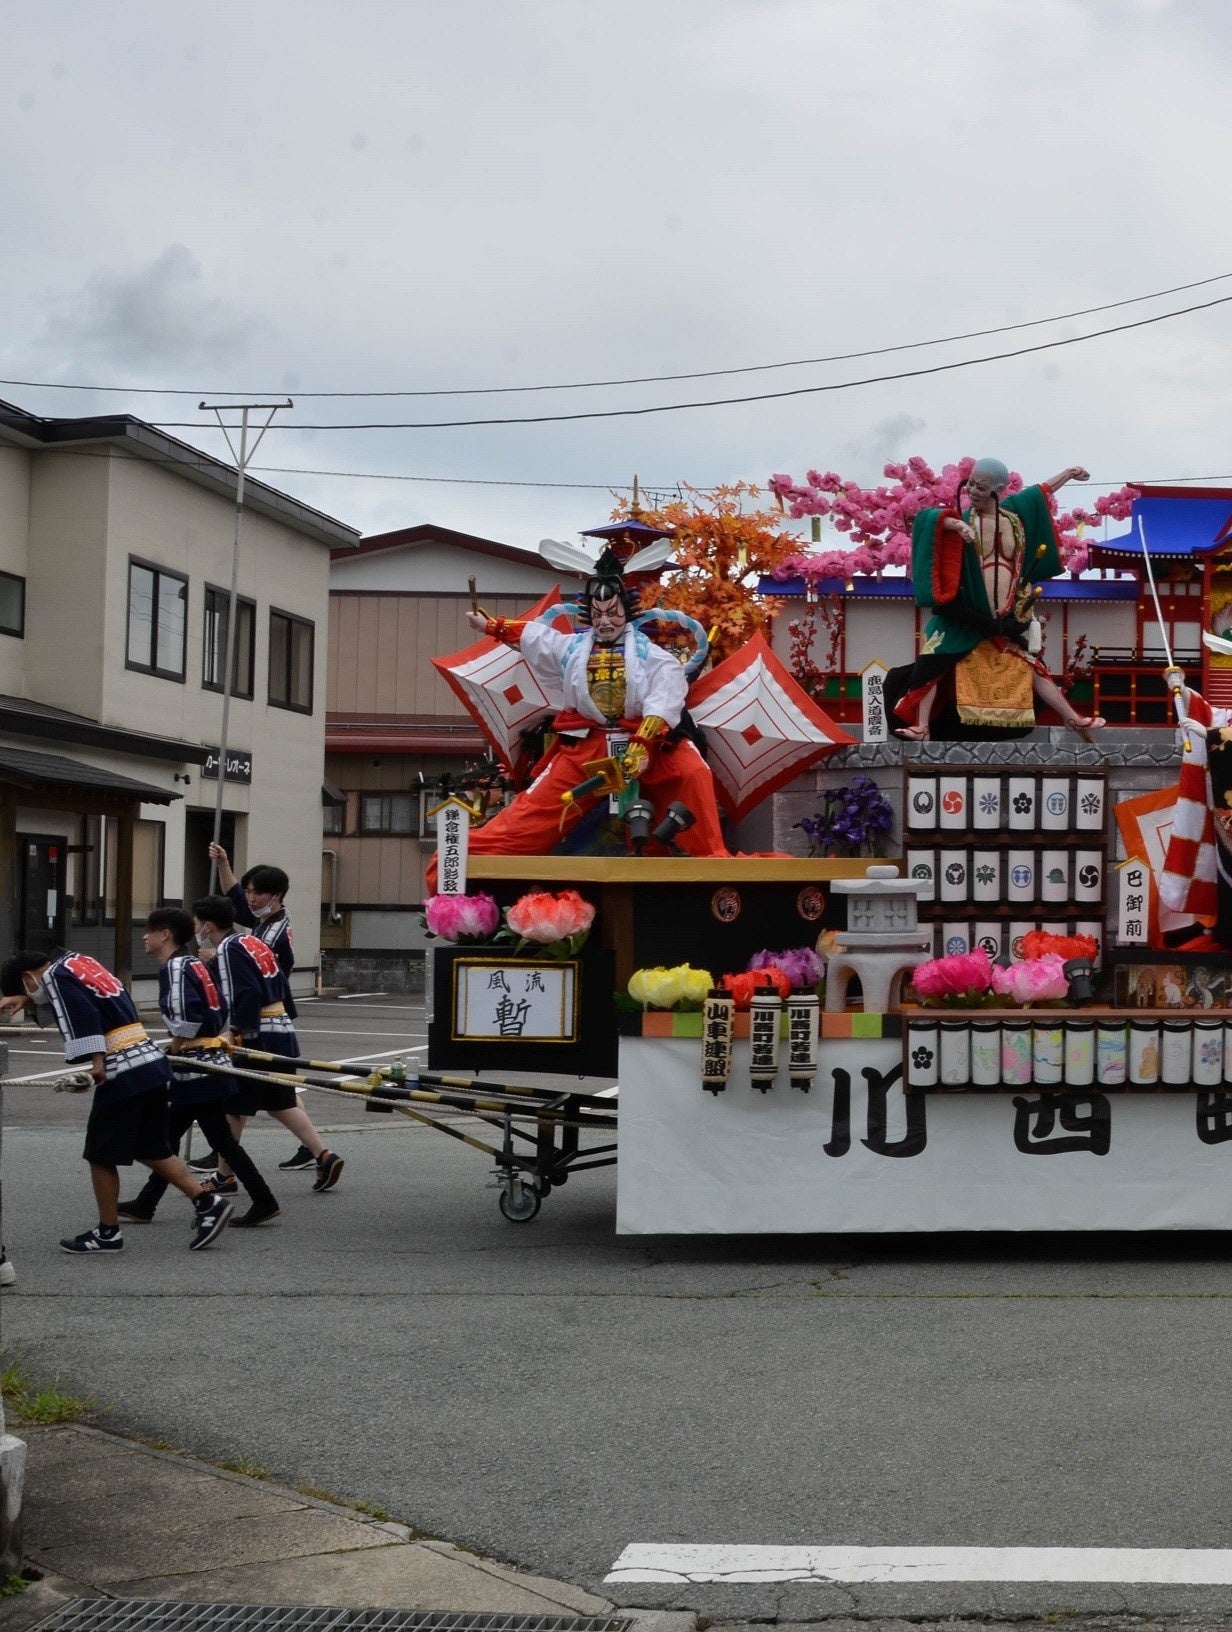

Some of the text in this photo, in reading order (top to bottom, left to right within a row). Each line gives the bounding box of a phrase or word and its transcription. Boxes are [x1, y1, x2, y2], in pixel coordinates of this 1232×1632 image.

[1126, 869, 1144, 937] 巴御前
[487, 969, 545, 993] 風流
[492, 994, 532, 1036] 暫
[703, 1003, 729, 1077] 山車連盟
